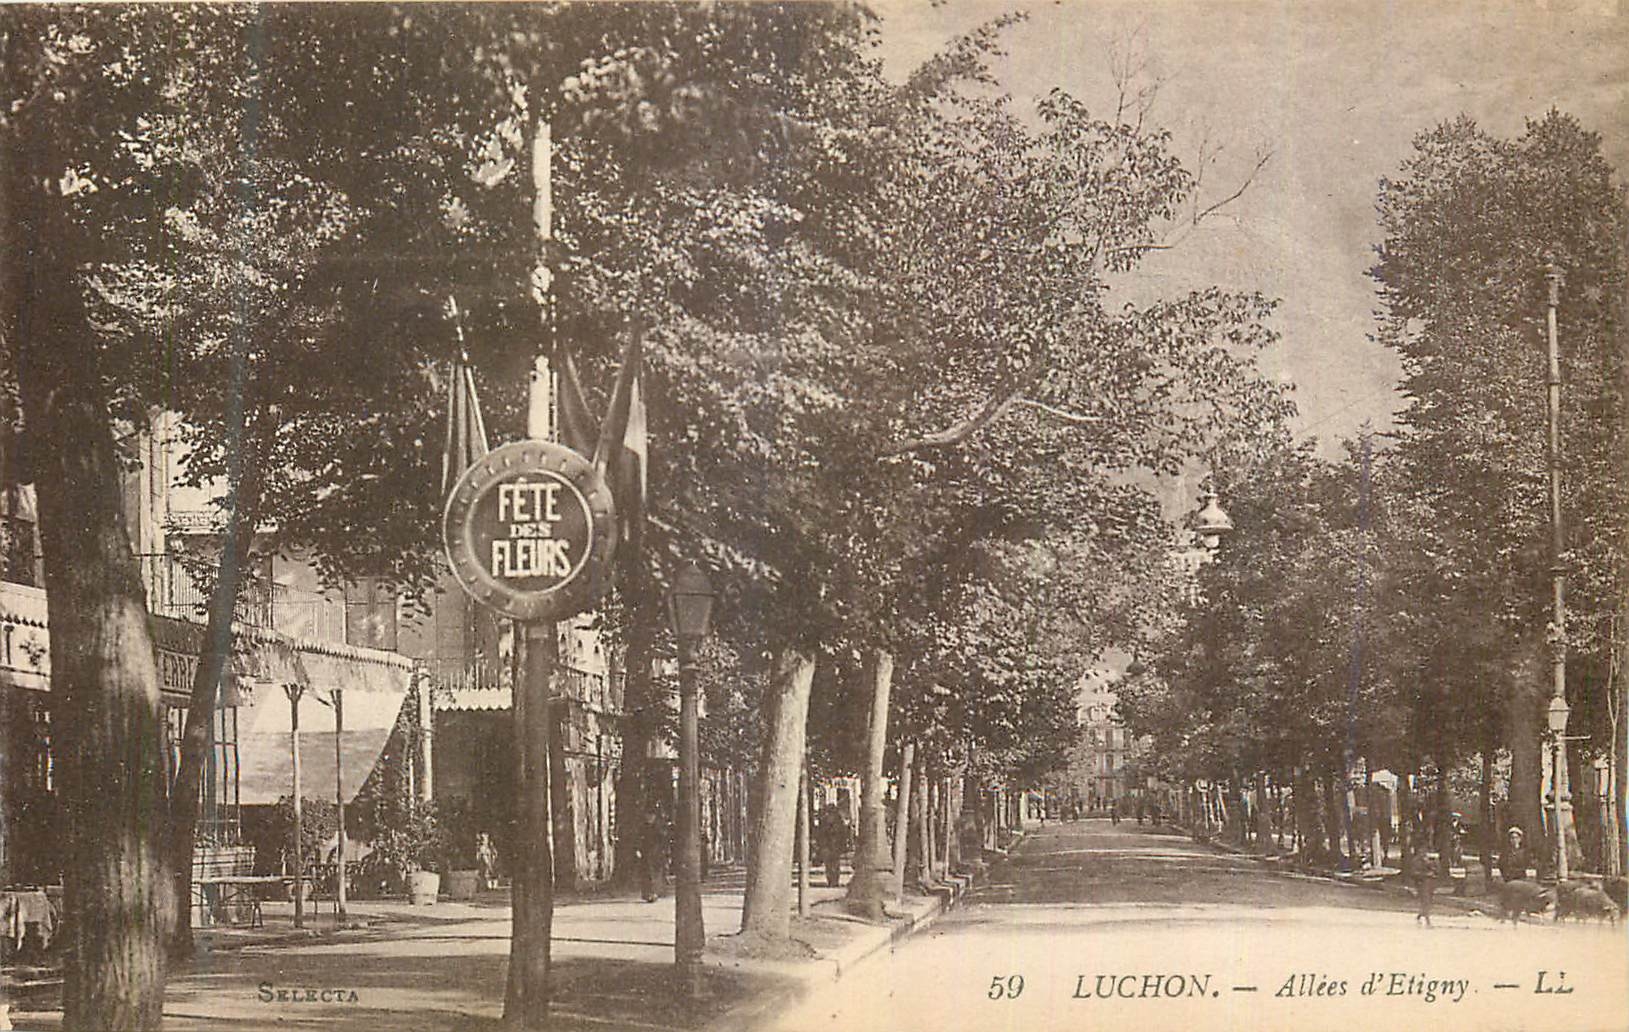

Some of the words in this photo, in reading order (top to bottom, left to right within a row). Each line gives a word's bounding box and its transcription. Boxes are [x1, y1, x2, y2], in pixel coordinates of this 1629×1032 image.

[498, 476, 562, 522] FÊTE
[509, 522, 552, 538] DES
[491, 538, 571, 577] FLEURS
